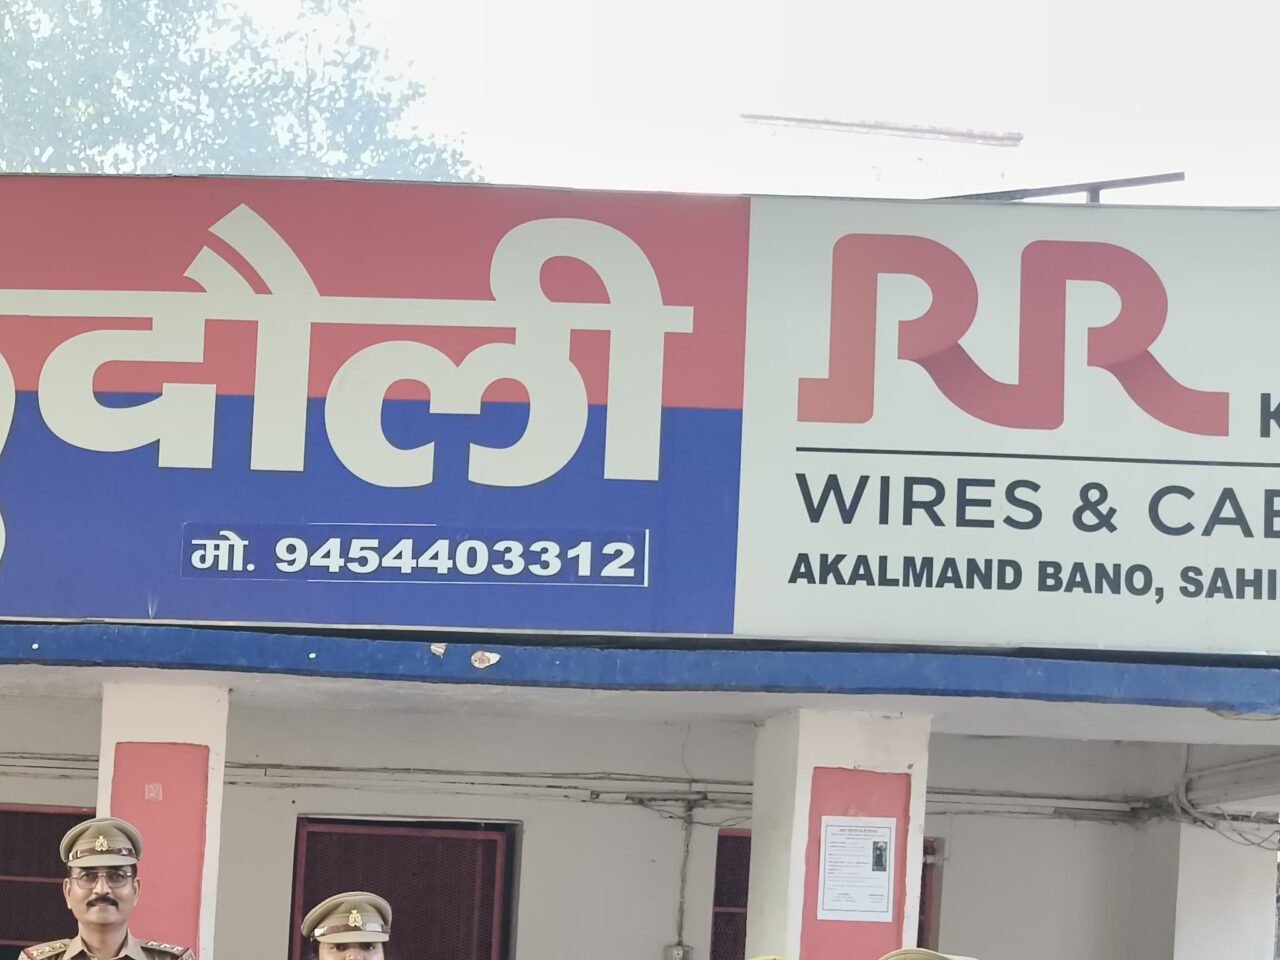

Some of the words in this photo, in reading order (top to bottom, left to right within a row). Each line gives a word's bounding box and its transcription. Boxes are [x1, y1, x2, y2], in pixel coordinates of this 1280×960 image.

[797, 233, 1230, 437] RR
[795, 473, 1043, 531] WIRES
[1072, 482, 1118, 534] &
[190, 530, 257, 574] मो.
[275, 537, 636, 577] 9454403312
[788, 553, 1021, 591] AKALMAND
[1037, 561, 1165, 605] BANO,
[1179, 566, 1278, 601] SAHI
